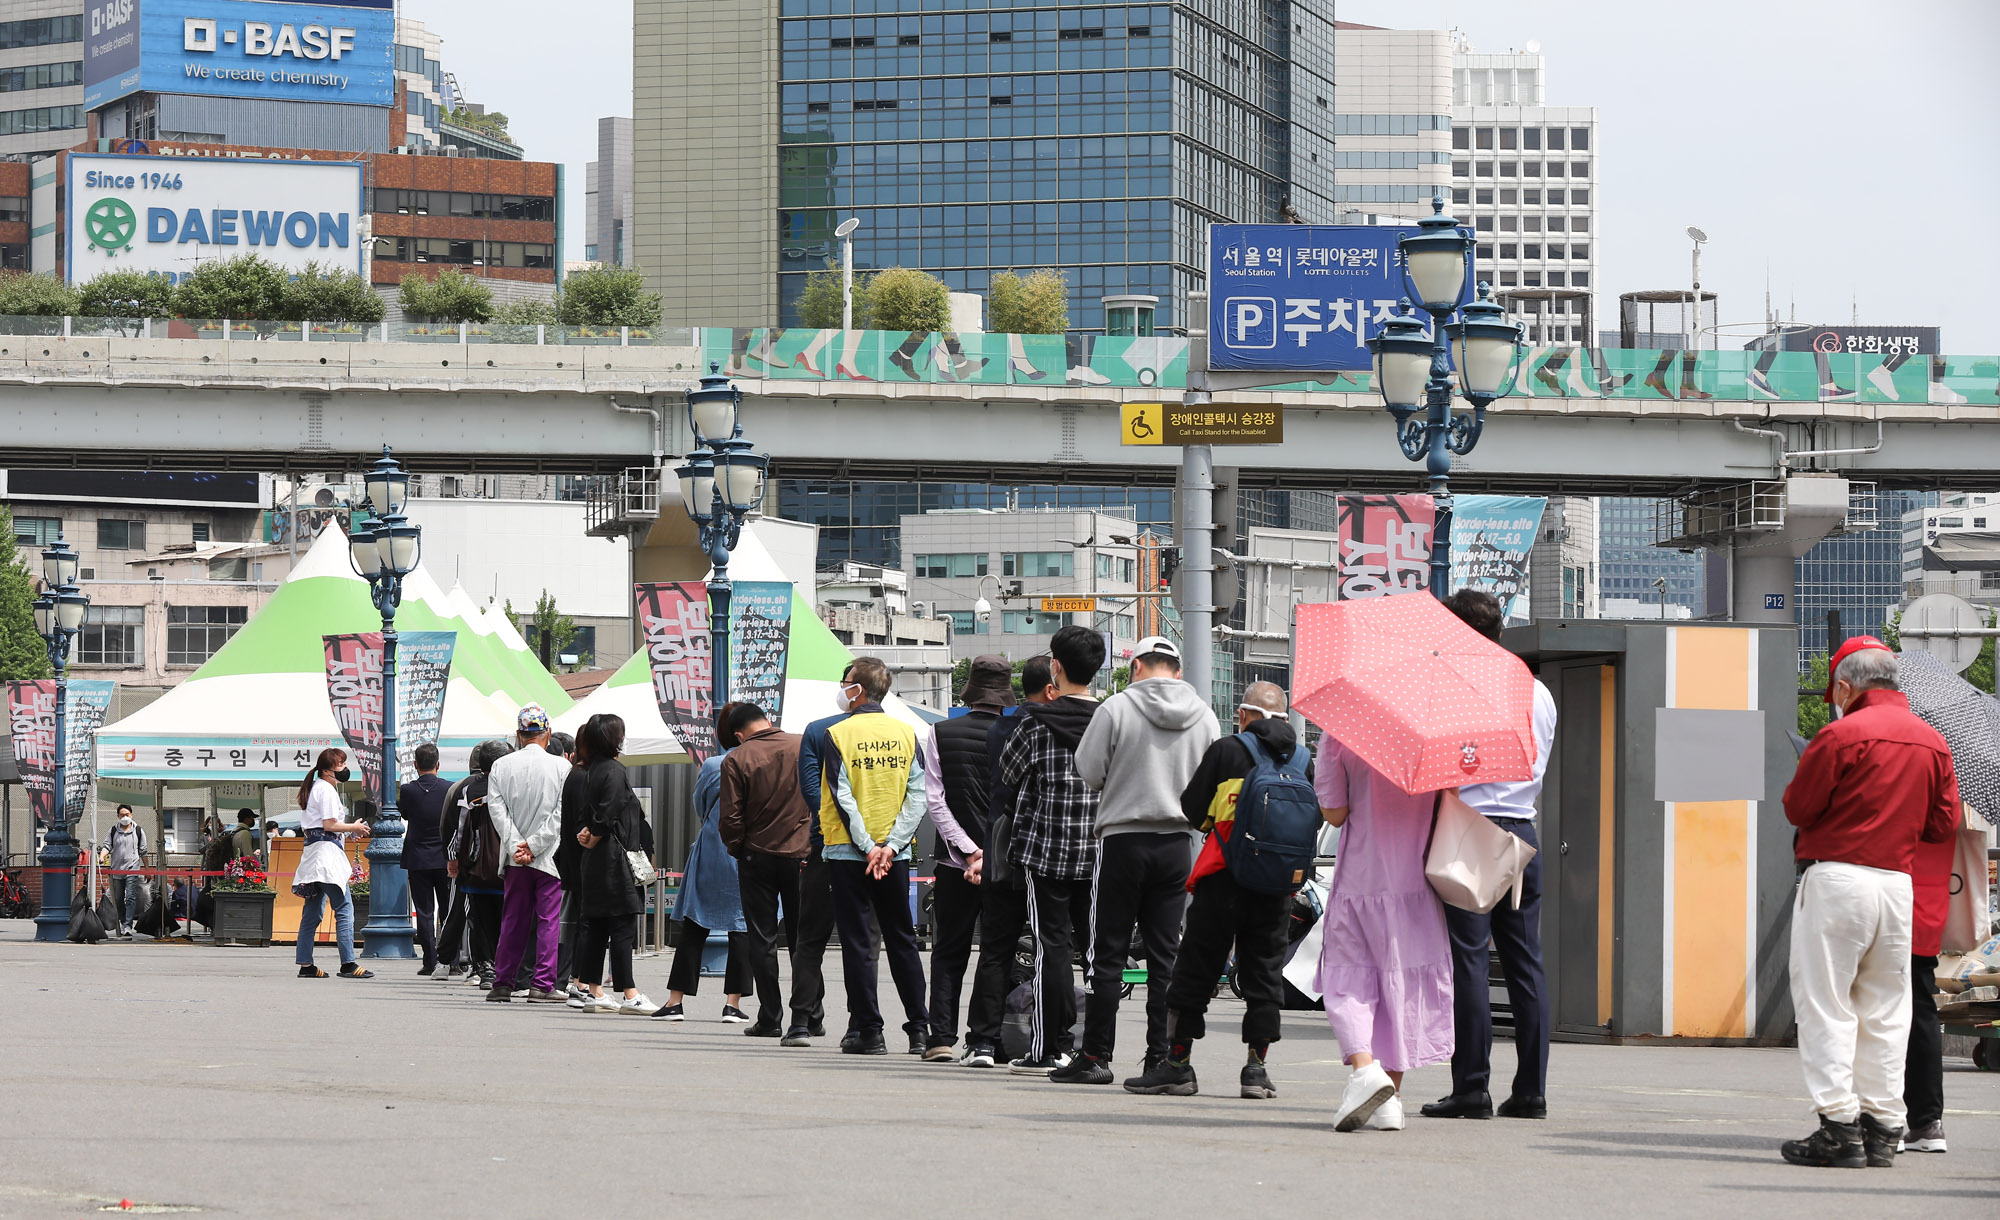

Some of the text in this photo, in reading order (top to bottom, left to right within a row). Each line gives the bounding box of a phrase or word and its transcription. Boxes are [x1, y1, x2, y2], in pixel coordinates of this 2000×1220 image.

[106, 0, 133, 30] BASF
[245, 21, 356, 60] BASF
[185, 62, 349, 90] We create chemistry
[85, 170, 183, 190] Since 1946
[147, 207, 349, 248] DAEWON
[1295, 247, 1378, 267] 롯데아울렛
[1225, 268, 1247, 276] Seoul
[1237, 304, 1263, 341] P
[1845, 335, 1919, 355] 한화생명
[1170, 412, 1275, 426] 장애인콜택시 승강장
[1455, 516, 1533, 530] Border-less.site
[1765, 596, 1784, 607] P12
[858, 740, 902, 752] 다시서기
[852, 756, 907, 770] 자활사업단
